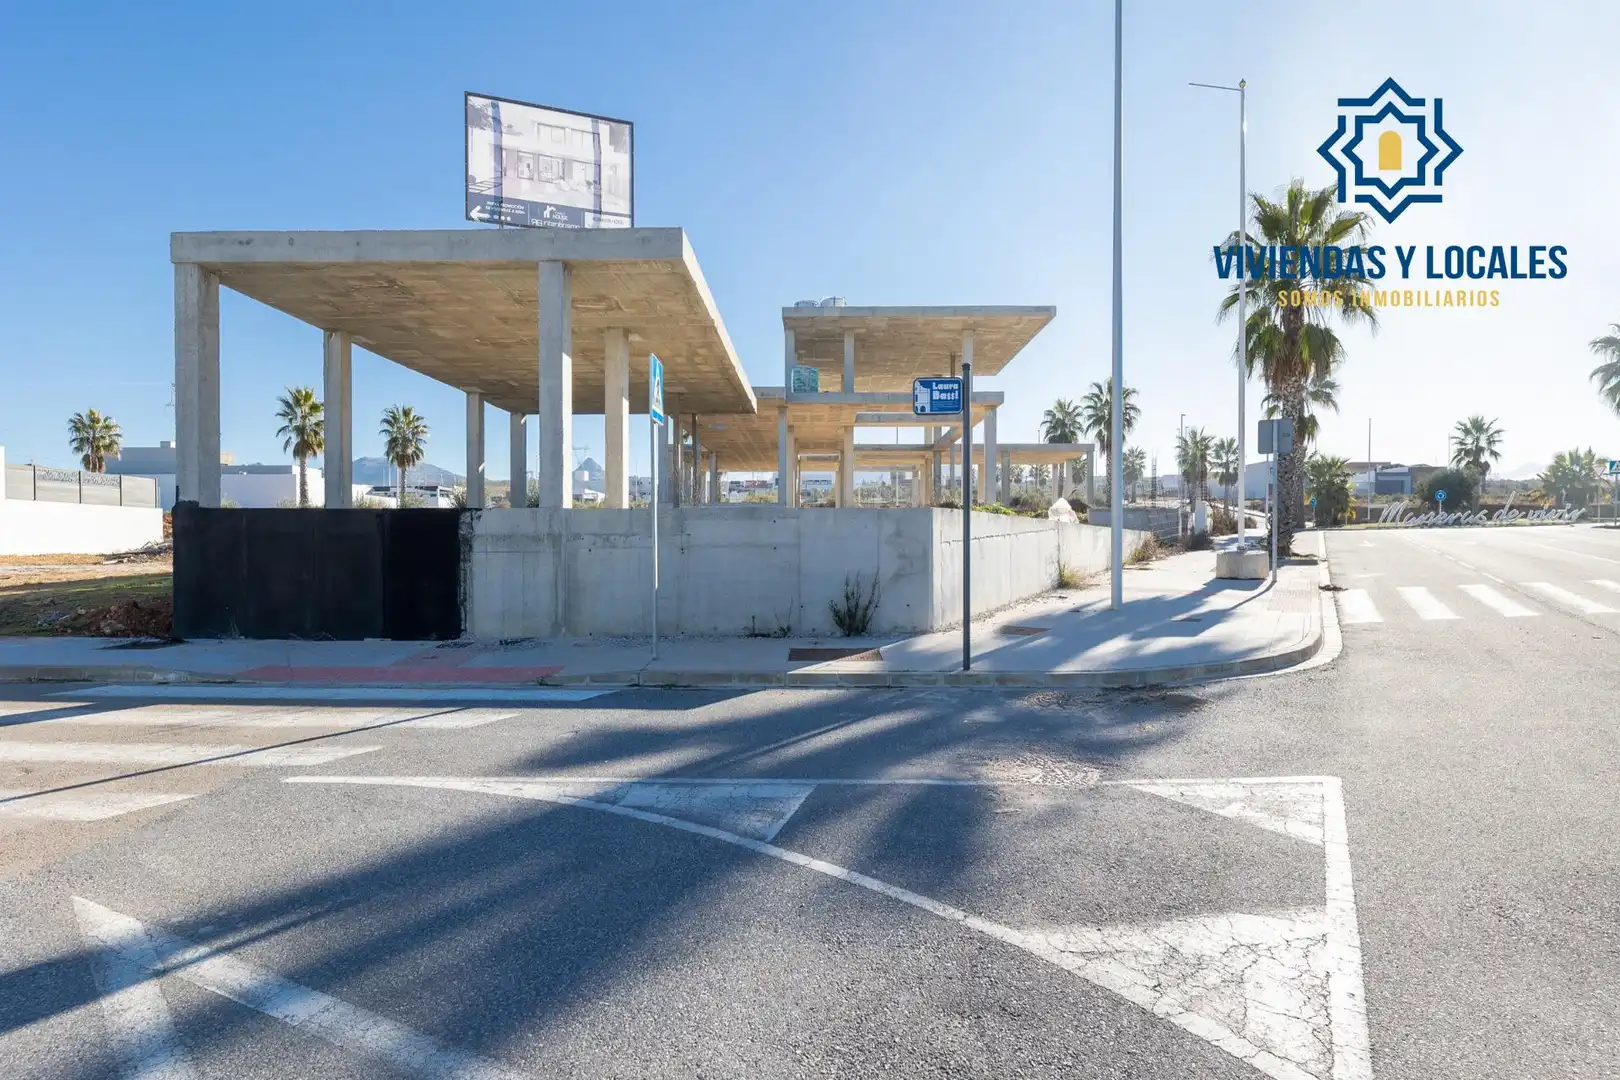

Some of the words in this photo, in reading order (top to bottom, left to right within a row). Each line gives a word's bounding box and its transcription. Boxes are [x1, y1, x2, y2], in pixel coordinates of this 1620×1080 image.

[932, 381, 959, 390] Laura
[1378, 499, 1489, 526] Maneras
[1492, 490, 1527, 521] de
